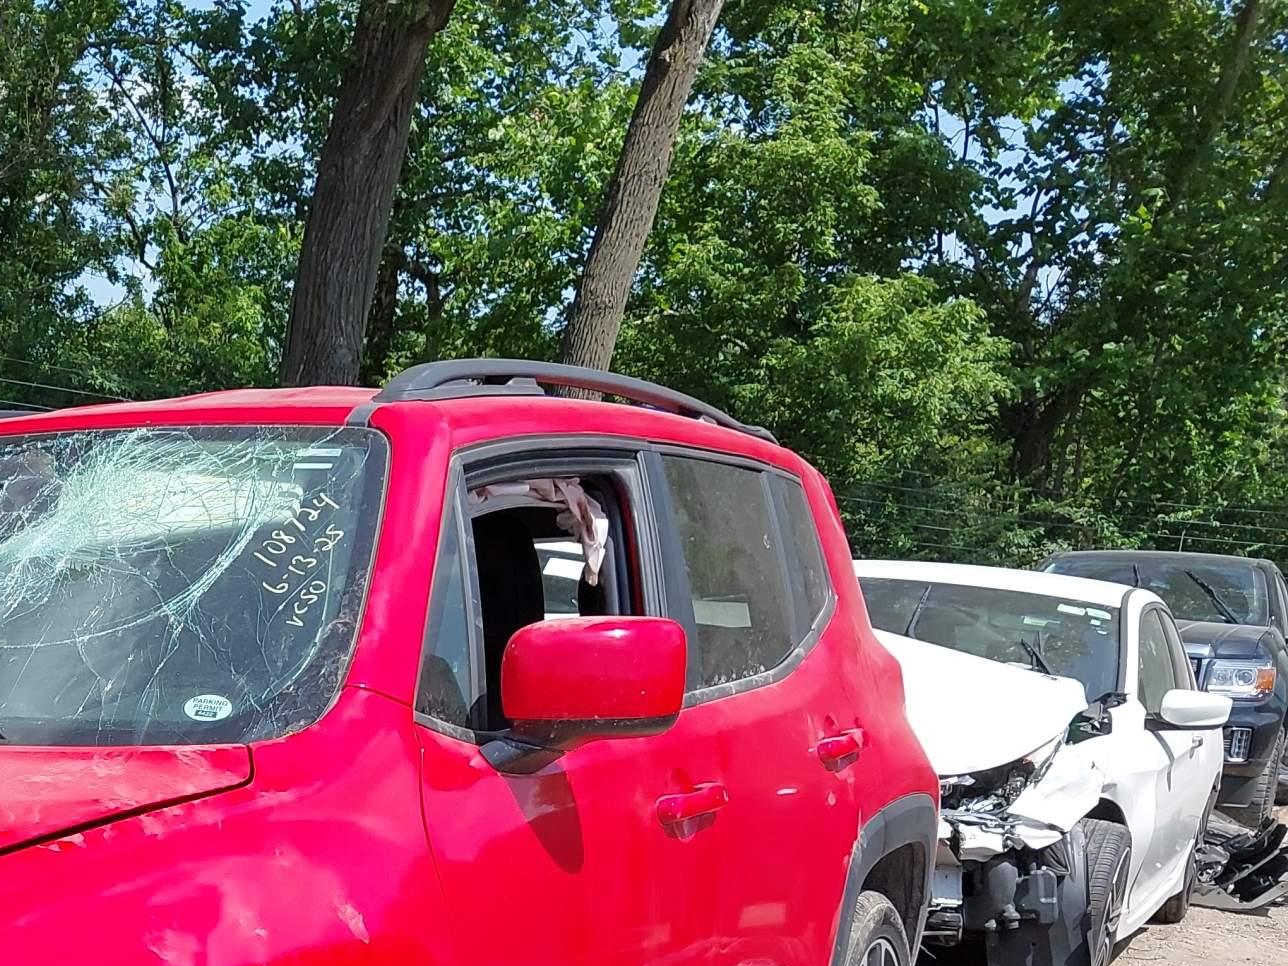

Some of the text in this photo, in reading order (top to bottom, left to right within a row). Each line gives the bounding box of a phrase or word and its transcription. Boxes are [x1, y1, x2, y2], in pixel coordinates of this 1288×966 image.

[254, 492, 340, 567] 108724
[193, 697, 229, 707] PARKING
[193, 703, 224, 712] PERMIT
